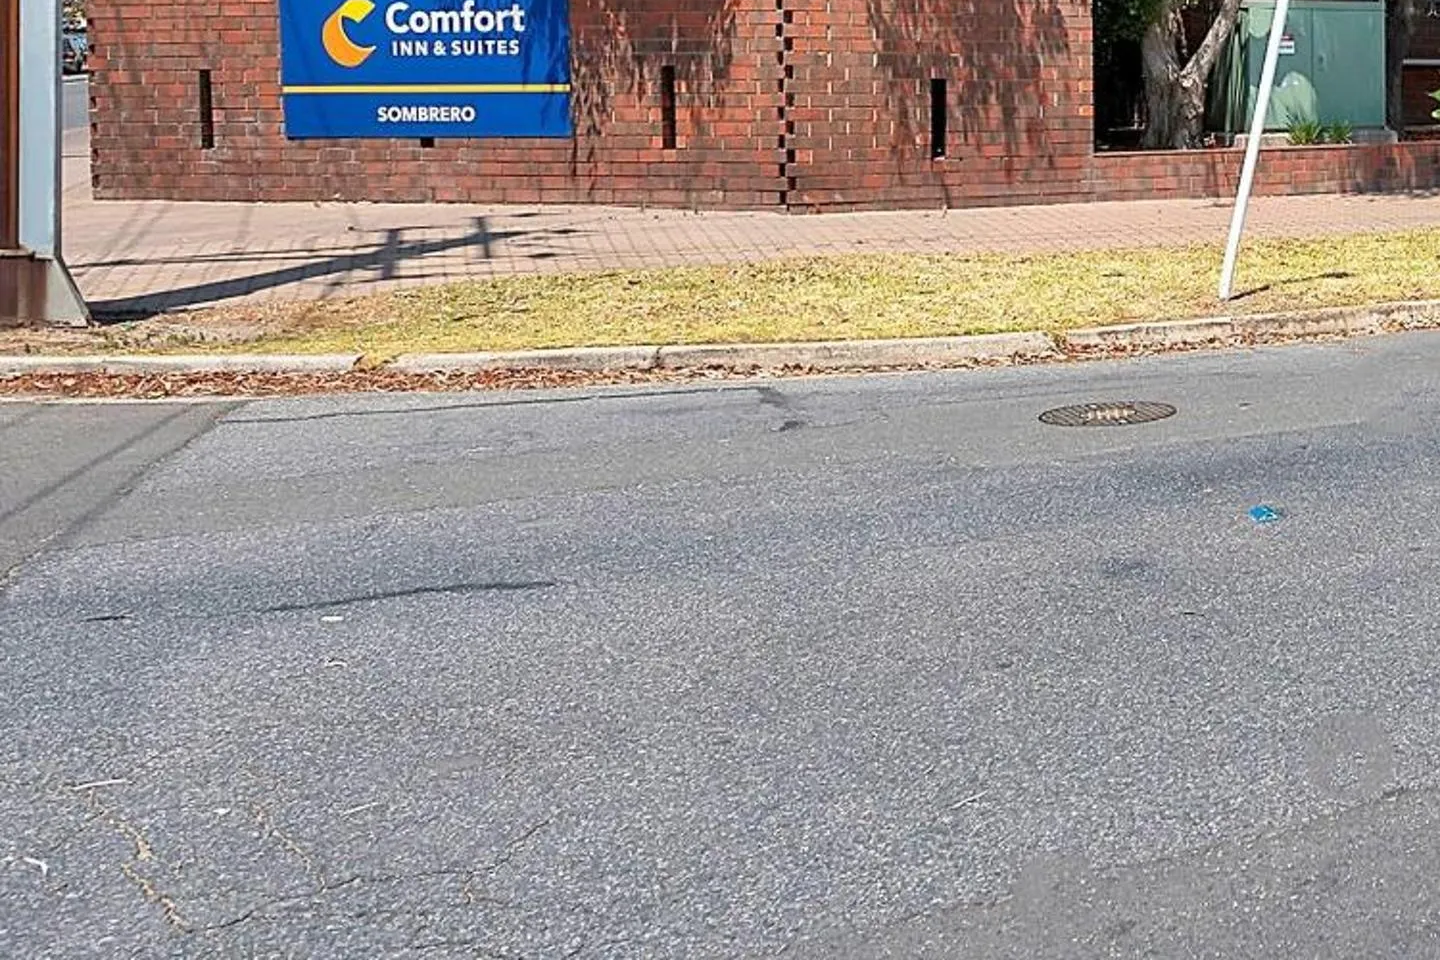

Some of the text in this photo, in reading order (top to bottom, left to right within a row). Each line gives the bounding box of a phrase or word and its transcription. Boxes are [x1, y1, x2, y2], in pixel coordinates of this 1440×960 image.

[384, 0, 526, 34] Comfort
[392, 39, 520, 57] INN & SUITES
[376, 106, 476, 123] SOMBRERO
